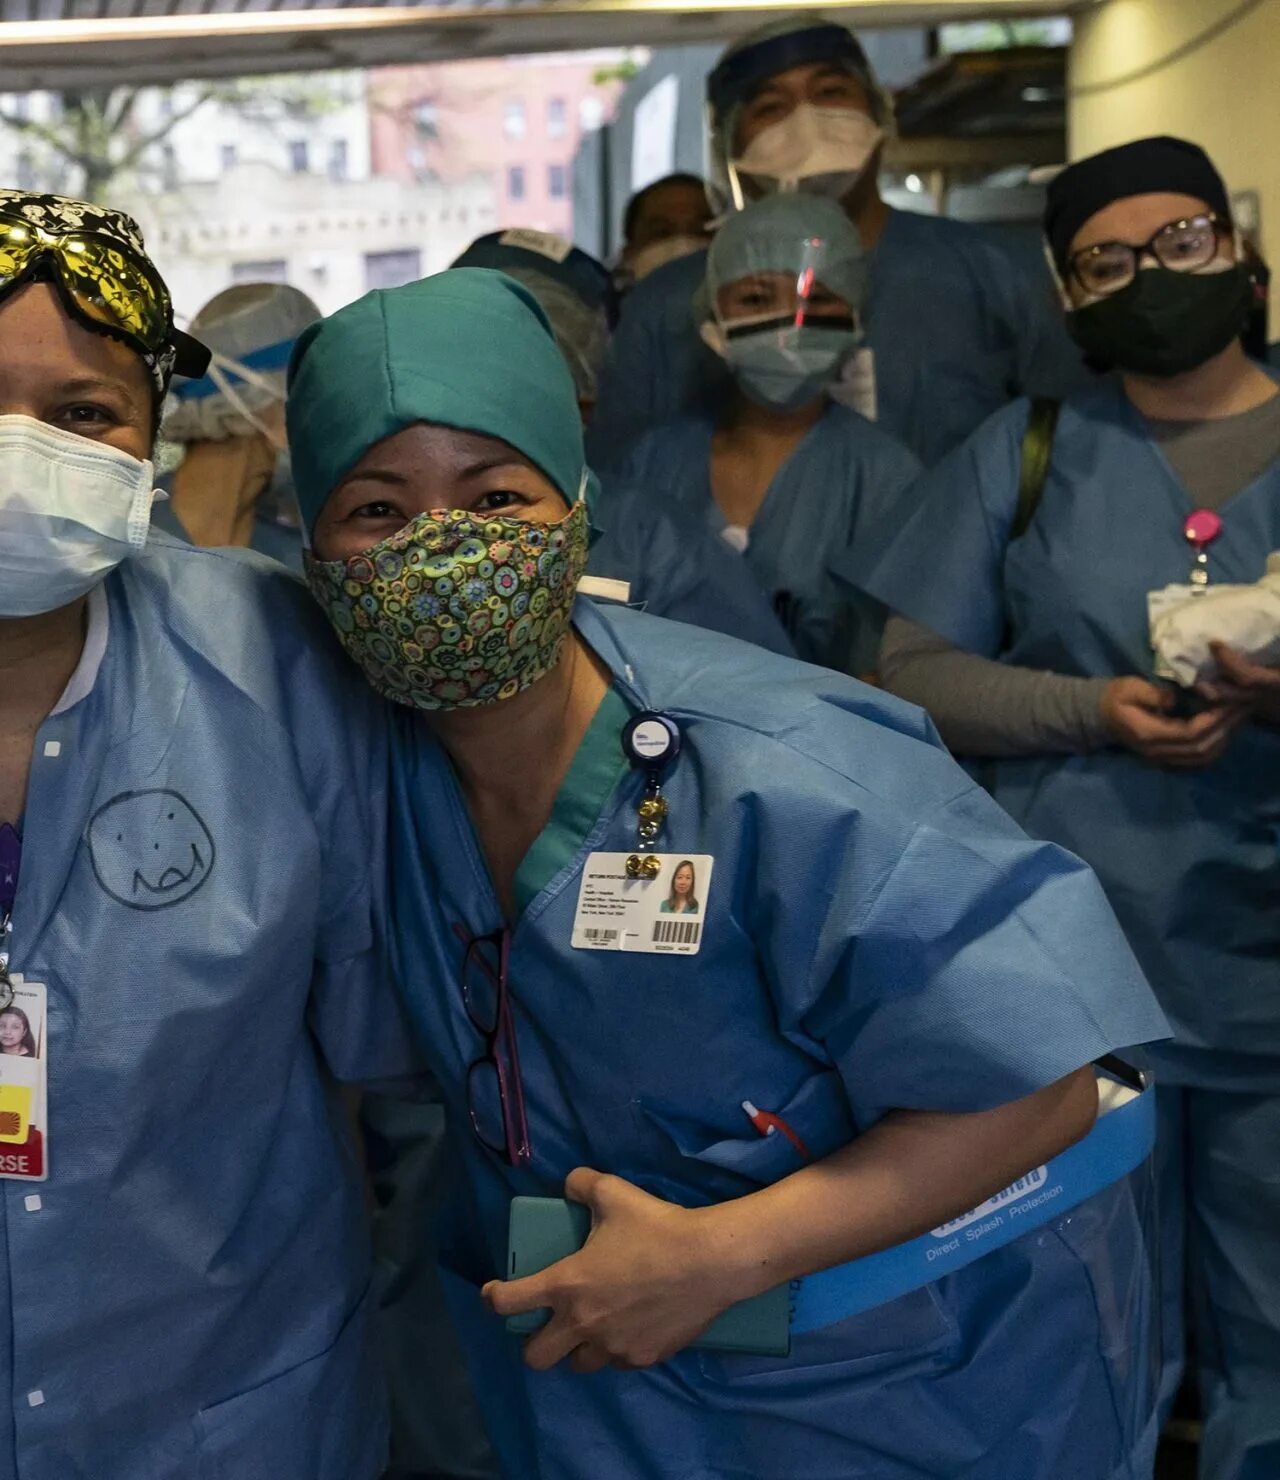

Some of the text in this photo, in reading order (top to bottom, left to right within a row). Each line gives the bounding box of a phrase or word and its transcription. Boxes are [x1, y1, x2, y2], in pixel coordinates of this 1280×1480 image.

[926, 1239, 961, 1262] Direct
[965, 1215, 1004, 1241] Splash
[1009, 1184, 1064, 1219] Protection
